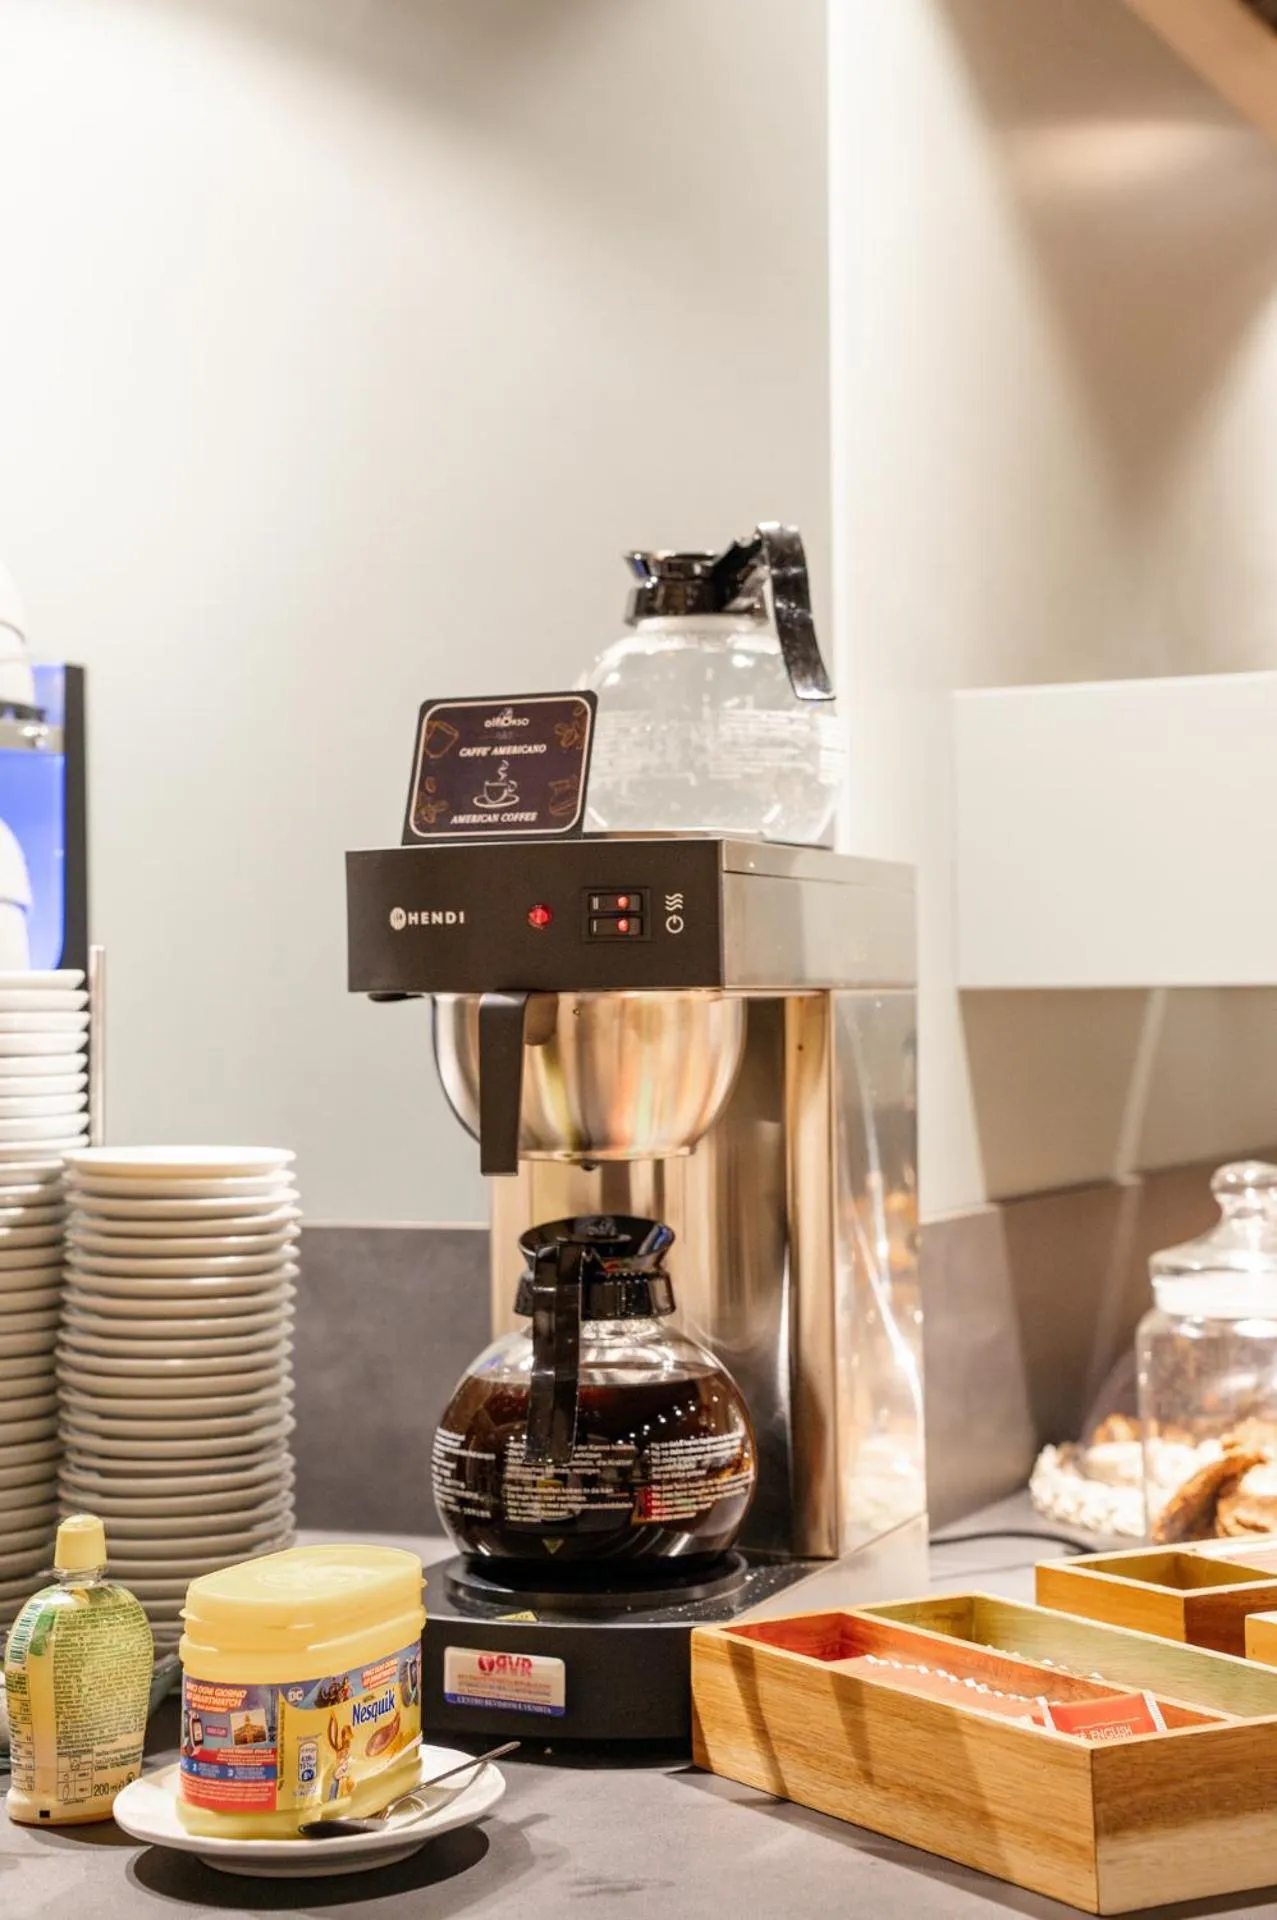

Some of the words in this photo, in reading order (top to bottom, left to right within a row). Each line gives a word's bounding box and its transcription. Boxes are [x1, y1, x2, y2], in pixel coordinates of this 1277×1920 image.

[491, 744, 547, 756] AMERICANO
[450, 813, 500, 825] AMERICAN
[500, 811, 538, 823] COFFEE
[408, 911, 464, 925] HENDI
[352, 1689, 396, 1726] Nesquik
[93, 1782, 110, 1797] 200
